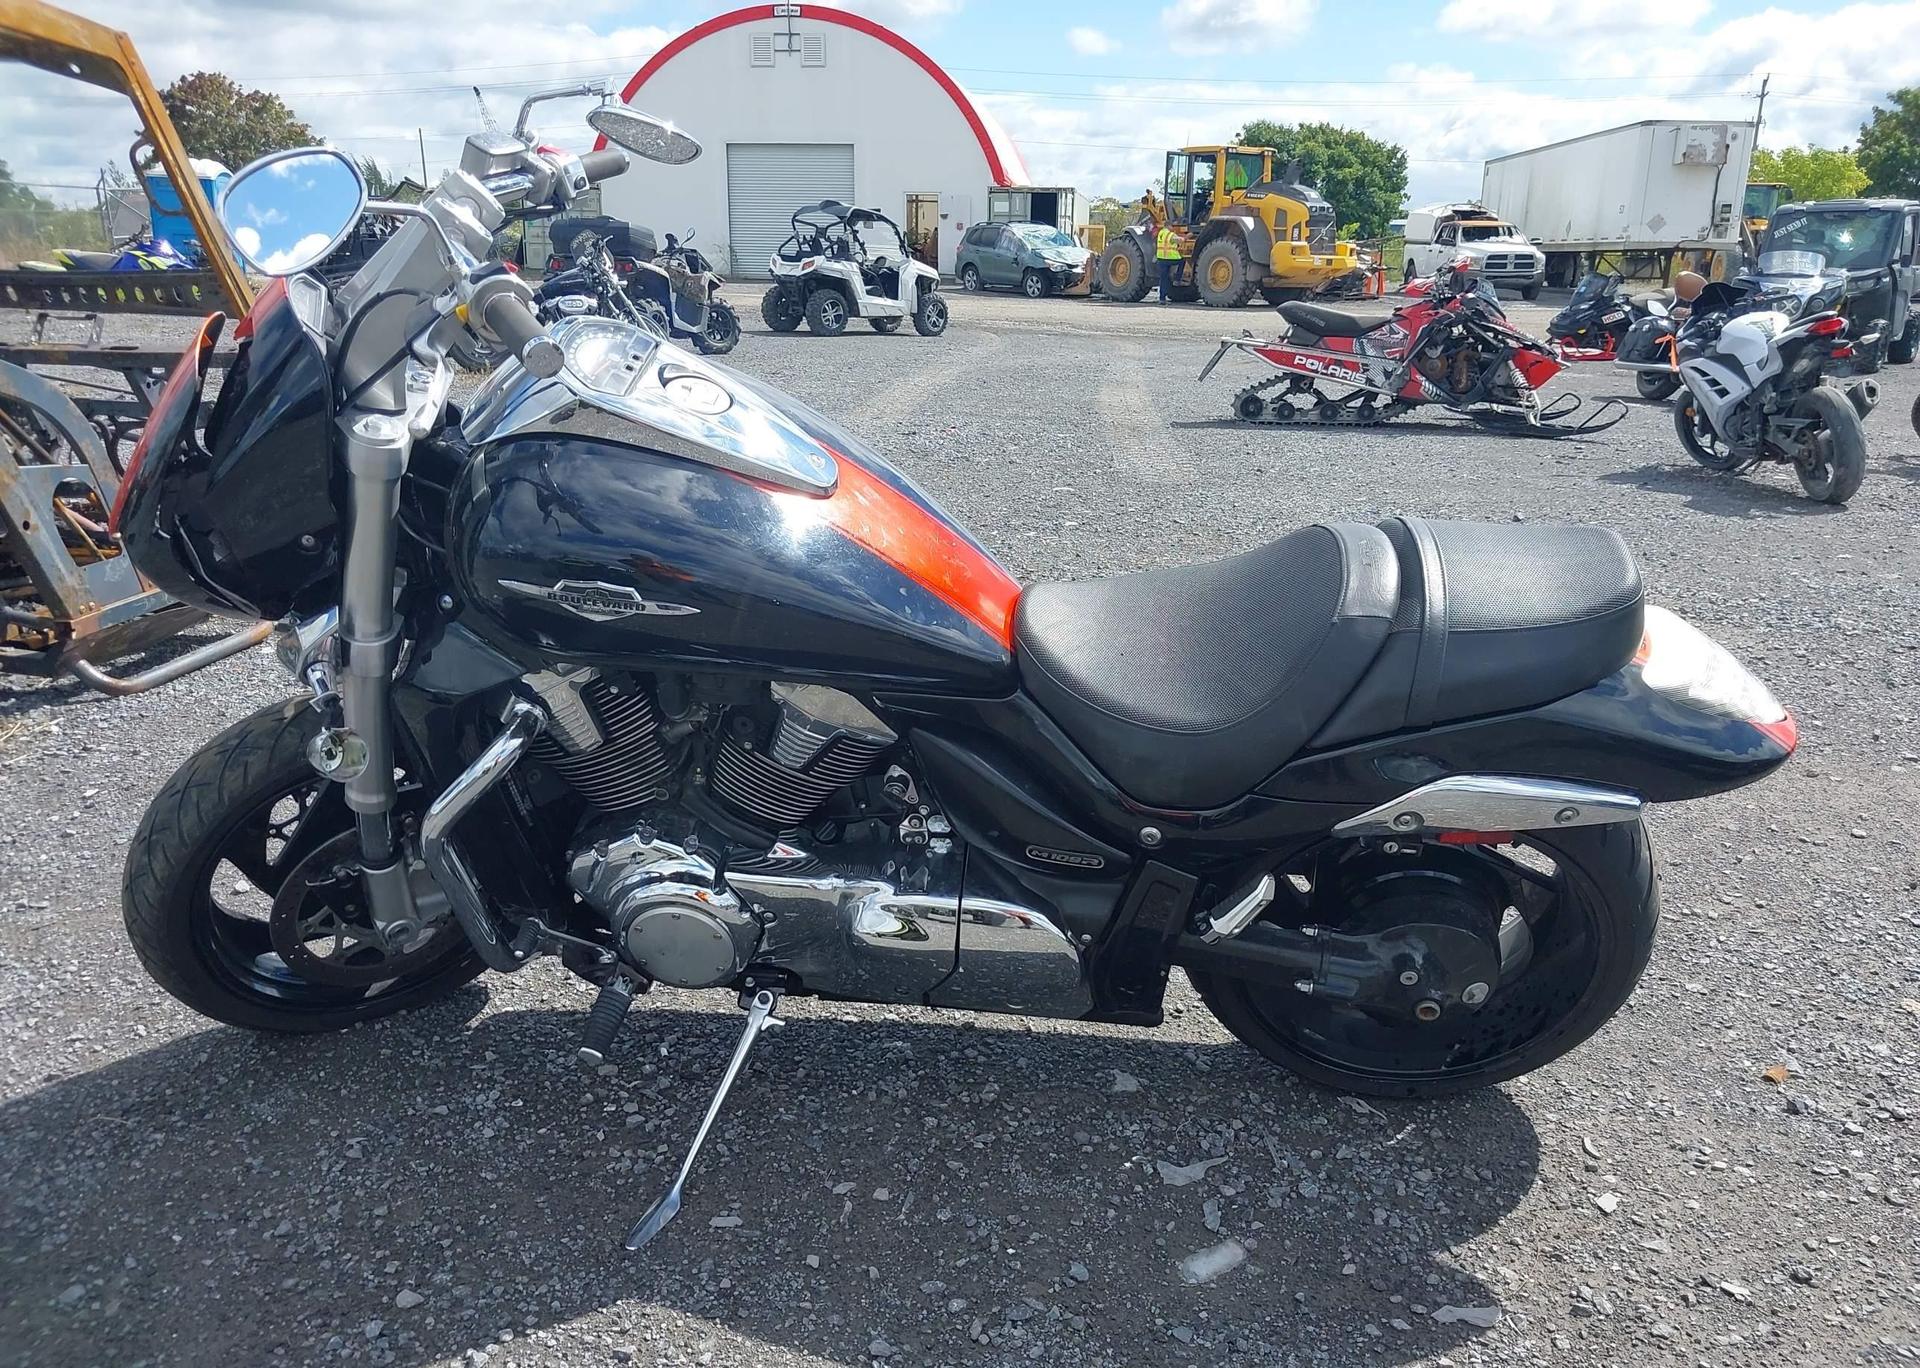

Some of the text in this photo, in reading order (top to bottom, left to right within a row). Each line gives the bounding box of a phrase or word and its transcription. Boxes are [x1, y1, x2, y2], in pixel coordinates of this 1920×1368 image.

[1774, 217, 1808, 238] JUST SEND IT
[1293, 355, 1367, 383] POLARIS
[548, 592, 646, 611] BOULEVARD
